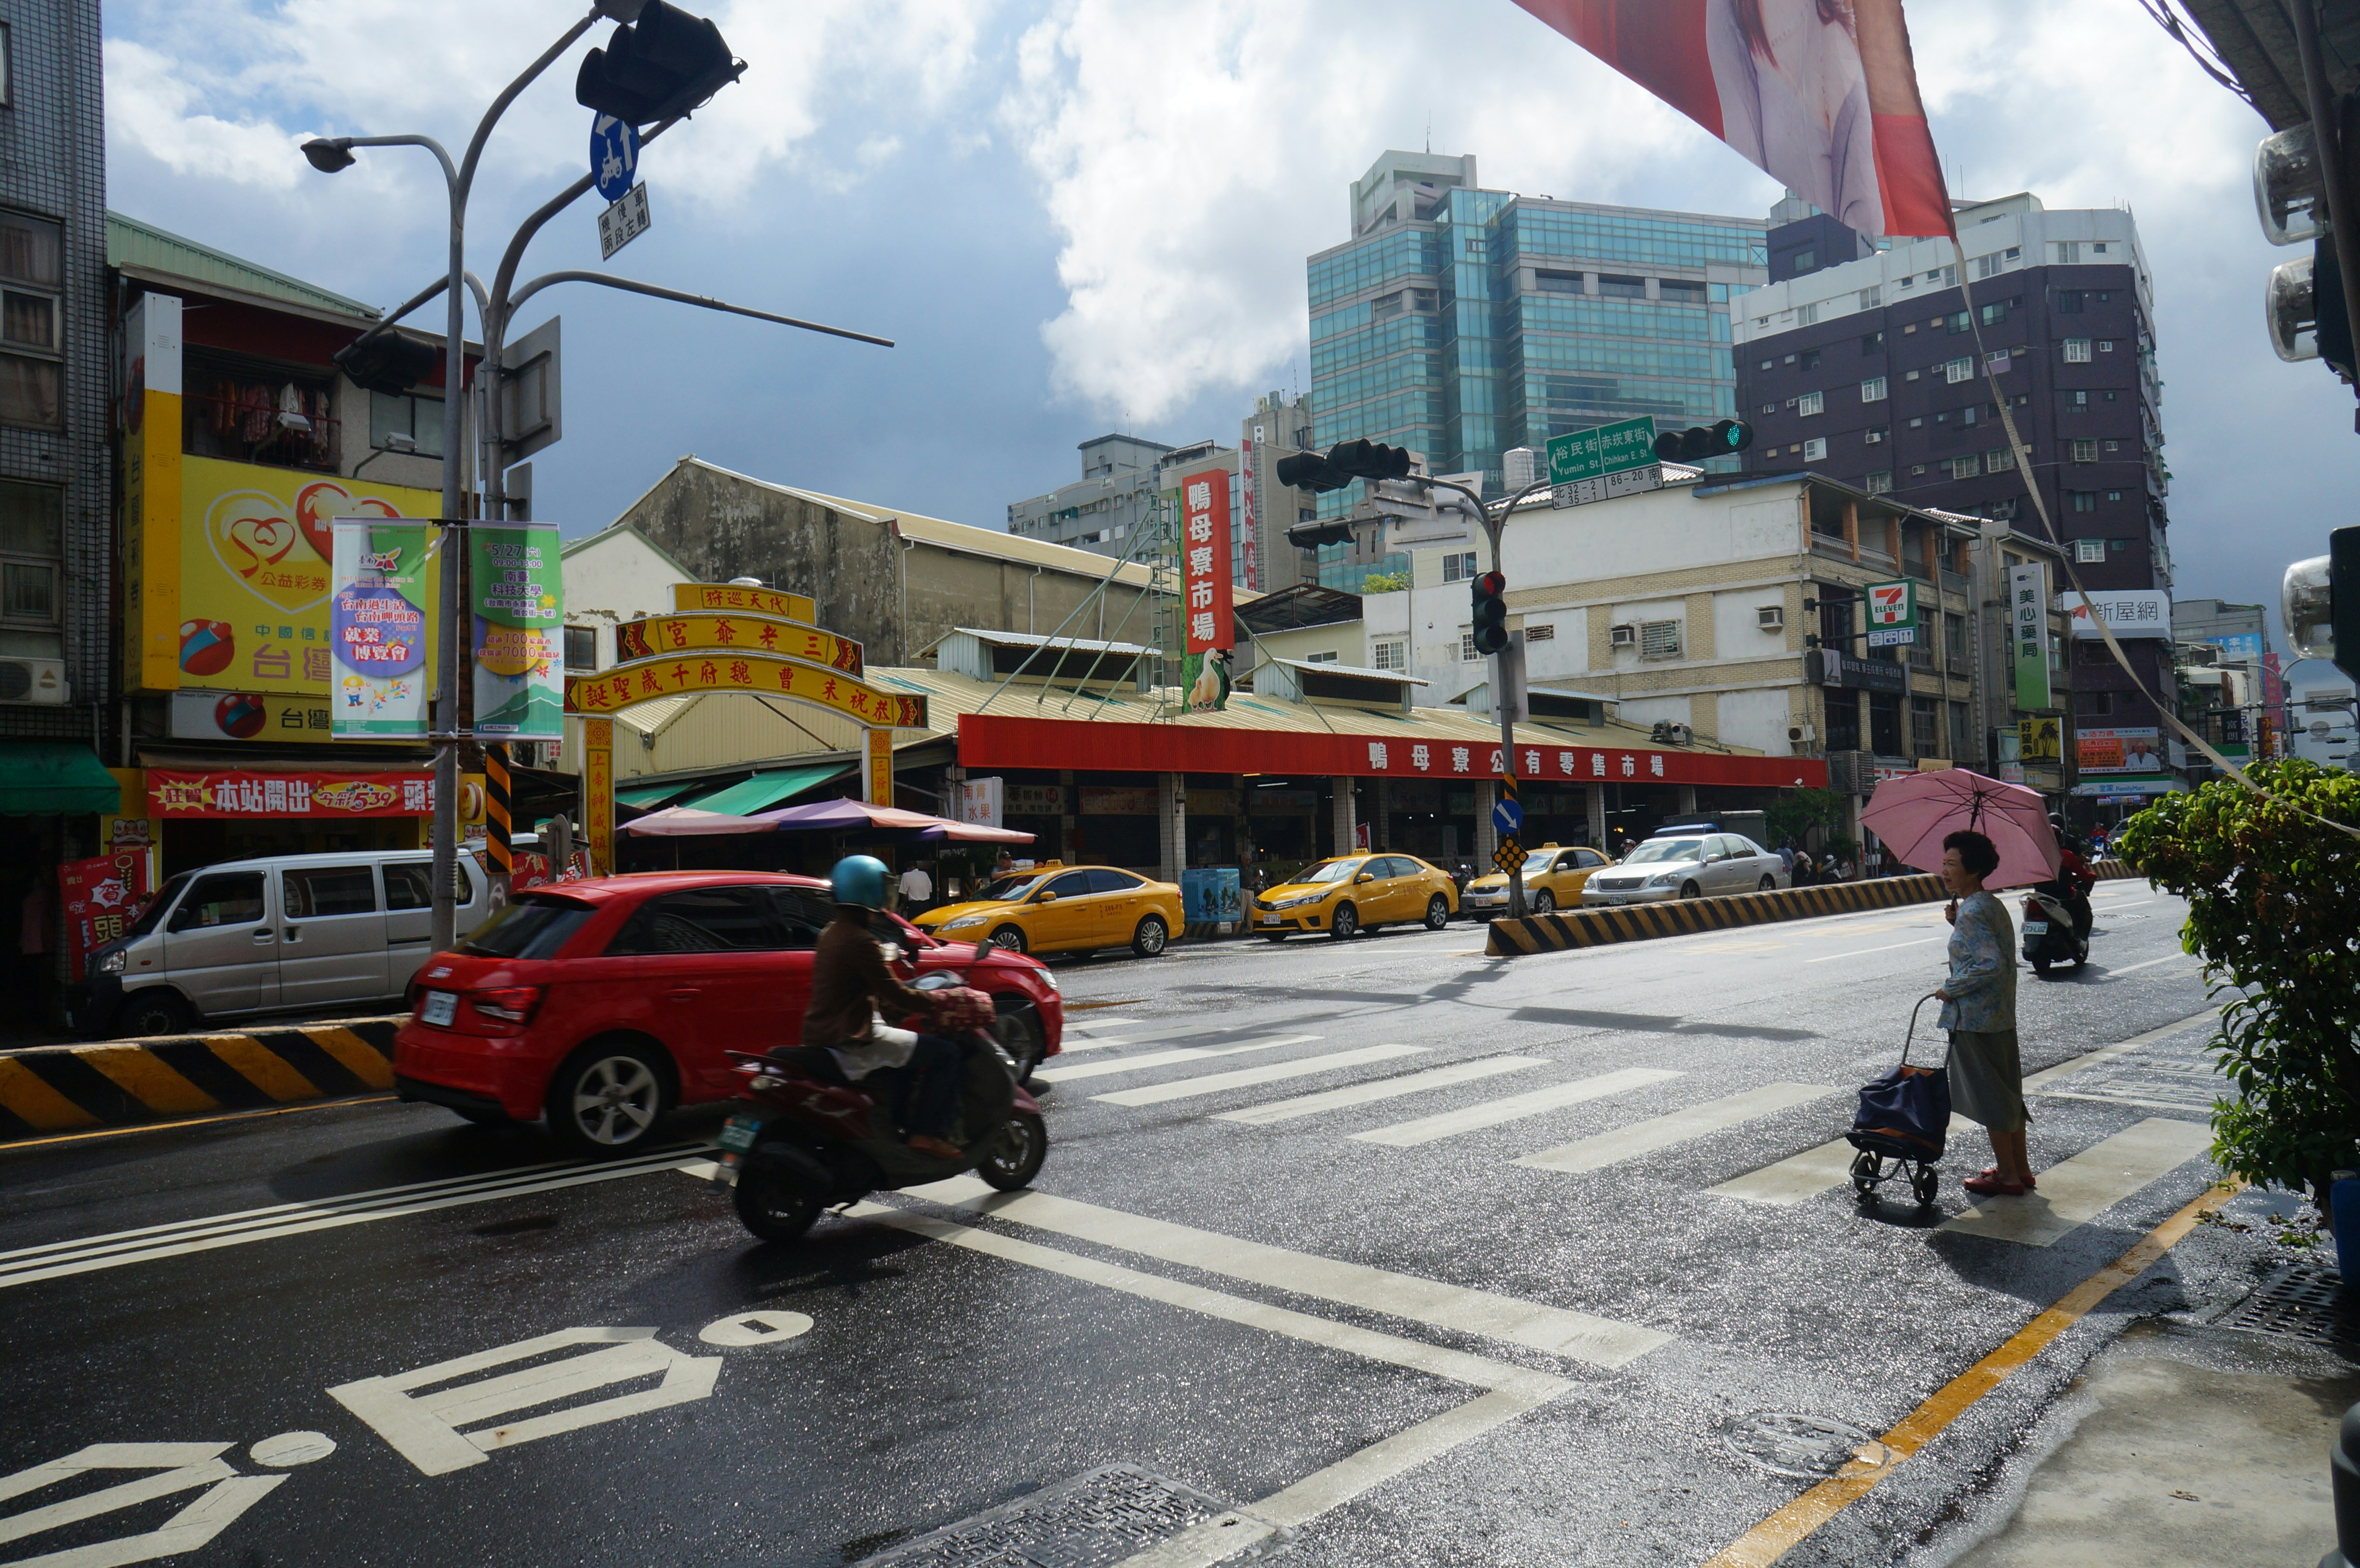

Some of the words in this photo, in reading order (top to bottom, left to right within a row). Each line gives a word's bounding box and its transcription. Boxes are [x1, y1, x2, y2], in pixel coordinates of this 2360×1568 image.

[601, 189, 644, 234] 機慢車
[603, 208, 647, 255] 兩段左轉
[1601, 427, 1646, 449] 赤崁東街
[1555, 438, 1598, 461] 裕民街
[1604, 453, 1629, 466] Chihkan
[1640, 449, 1648, 458] St.
[1558, 463, 1585, 476] Yumin
[1589, 459, 1601, 469] St.
[1648, 467, 1660, 480] 南
[1554, 488, 1565, 499] 北
[492, 544, 522, 557] 5/27
[1188, 481, 1216, 642] 鴨母寮市場
[260, 573, 327, 592] 公益彩券
[504, 571, 529, 582] 南臺
[492, 585, 542, 596] 科技大學
[342, 599, 406, 611] 台南過生活
[706, 590, 787, 614] 代天巡狩
[2092, 600, 2158, 622] 新屋網
[356, 612, 419, 623] 台南呷頭路
[2019, 588, 2038, 658] 美心藥局
[345, 626, 380, 643] 就業
[666, 618, 822, 657] 三老爺宮
[355, 645, 407, 661] 博覽會
[2021, 722, 2033, 755] 好望角
[1368, 741, 1664, 778] 鴨母寮公有零售市場
[165, 787, 204, 804] 狂賀
[215, 779, 310, 813] 本站開出
[318, 791, 392, 811] 今彩539
[99, 883, 121, 903] 賀
